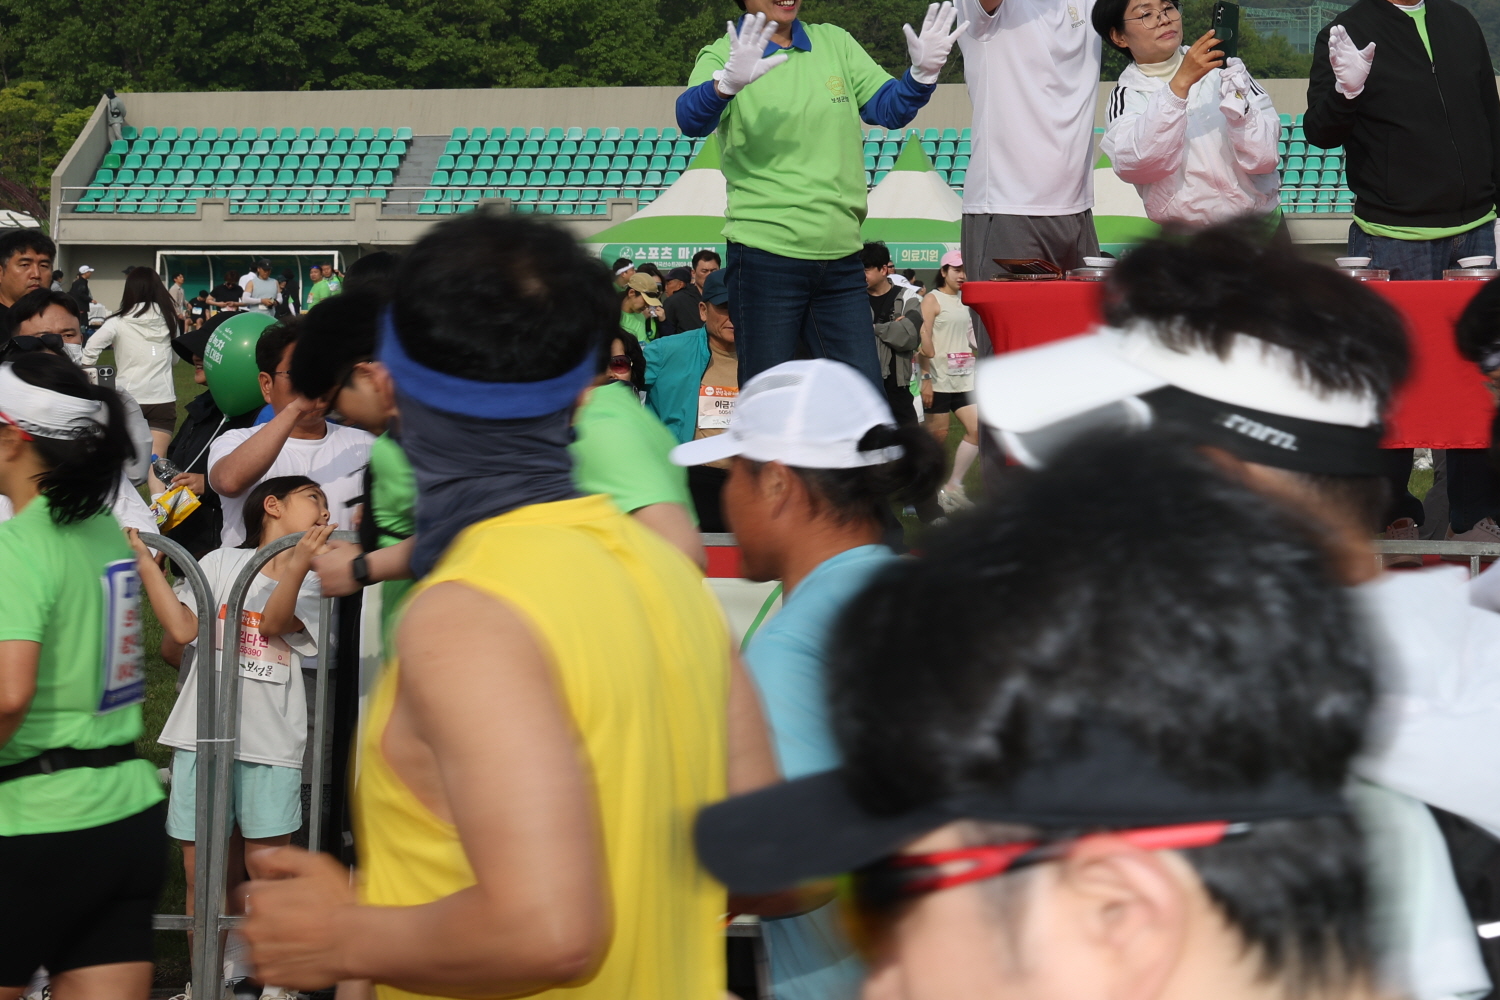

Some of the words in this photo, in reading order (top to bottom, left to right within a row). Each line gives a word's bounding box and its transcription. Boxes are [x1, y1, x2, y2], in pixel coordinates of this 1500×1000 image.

[634, 246, 673, 260] 스포츠
[678, 246, 716, 260] 마사
[901, 249, 939, 262] 의료지원
